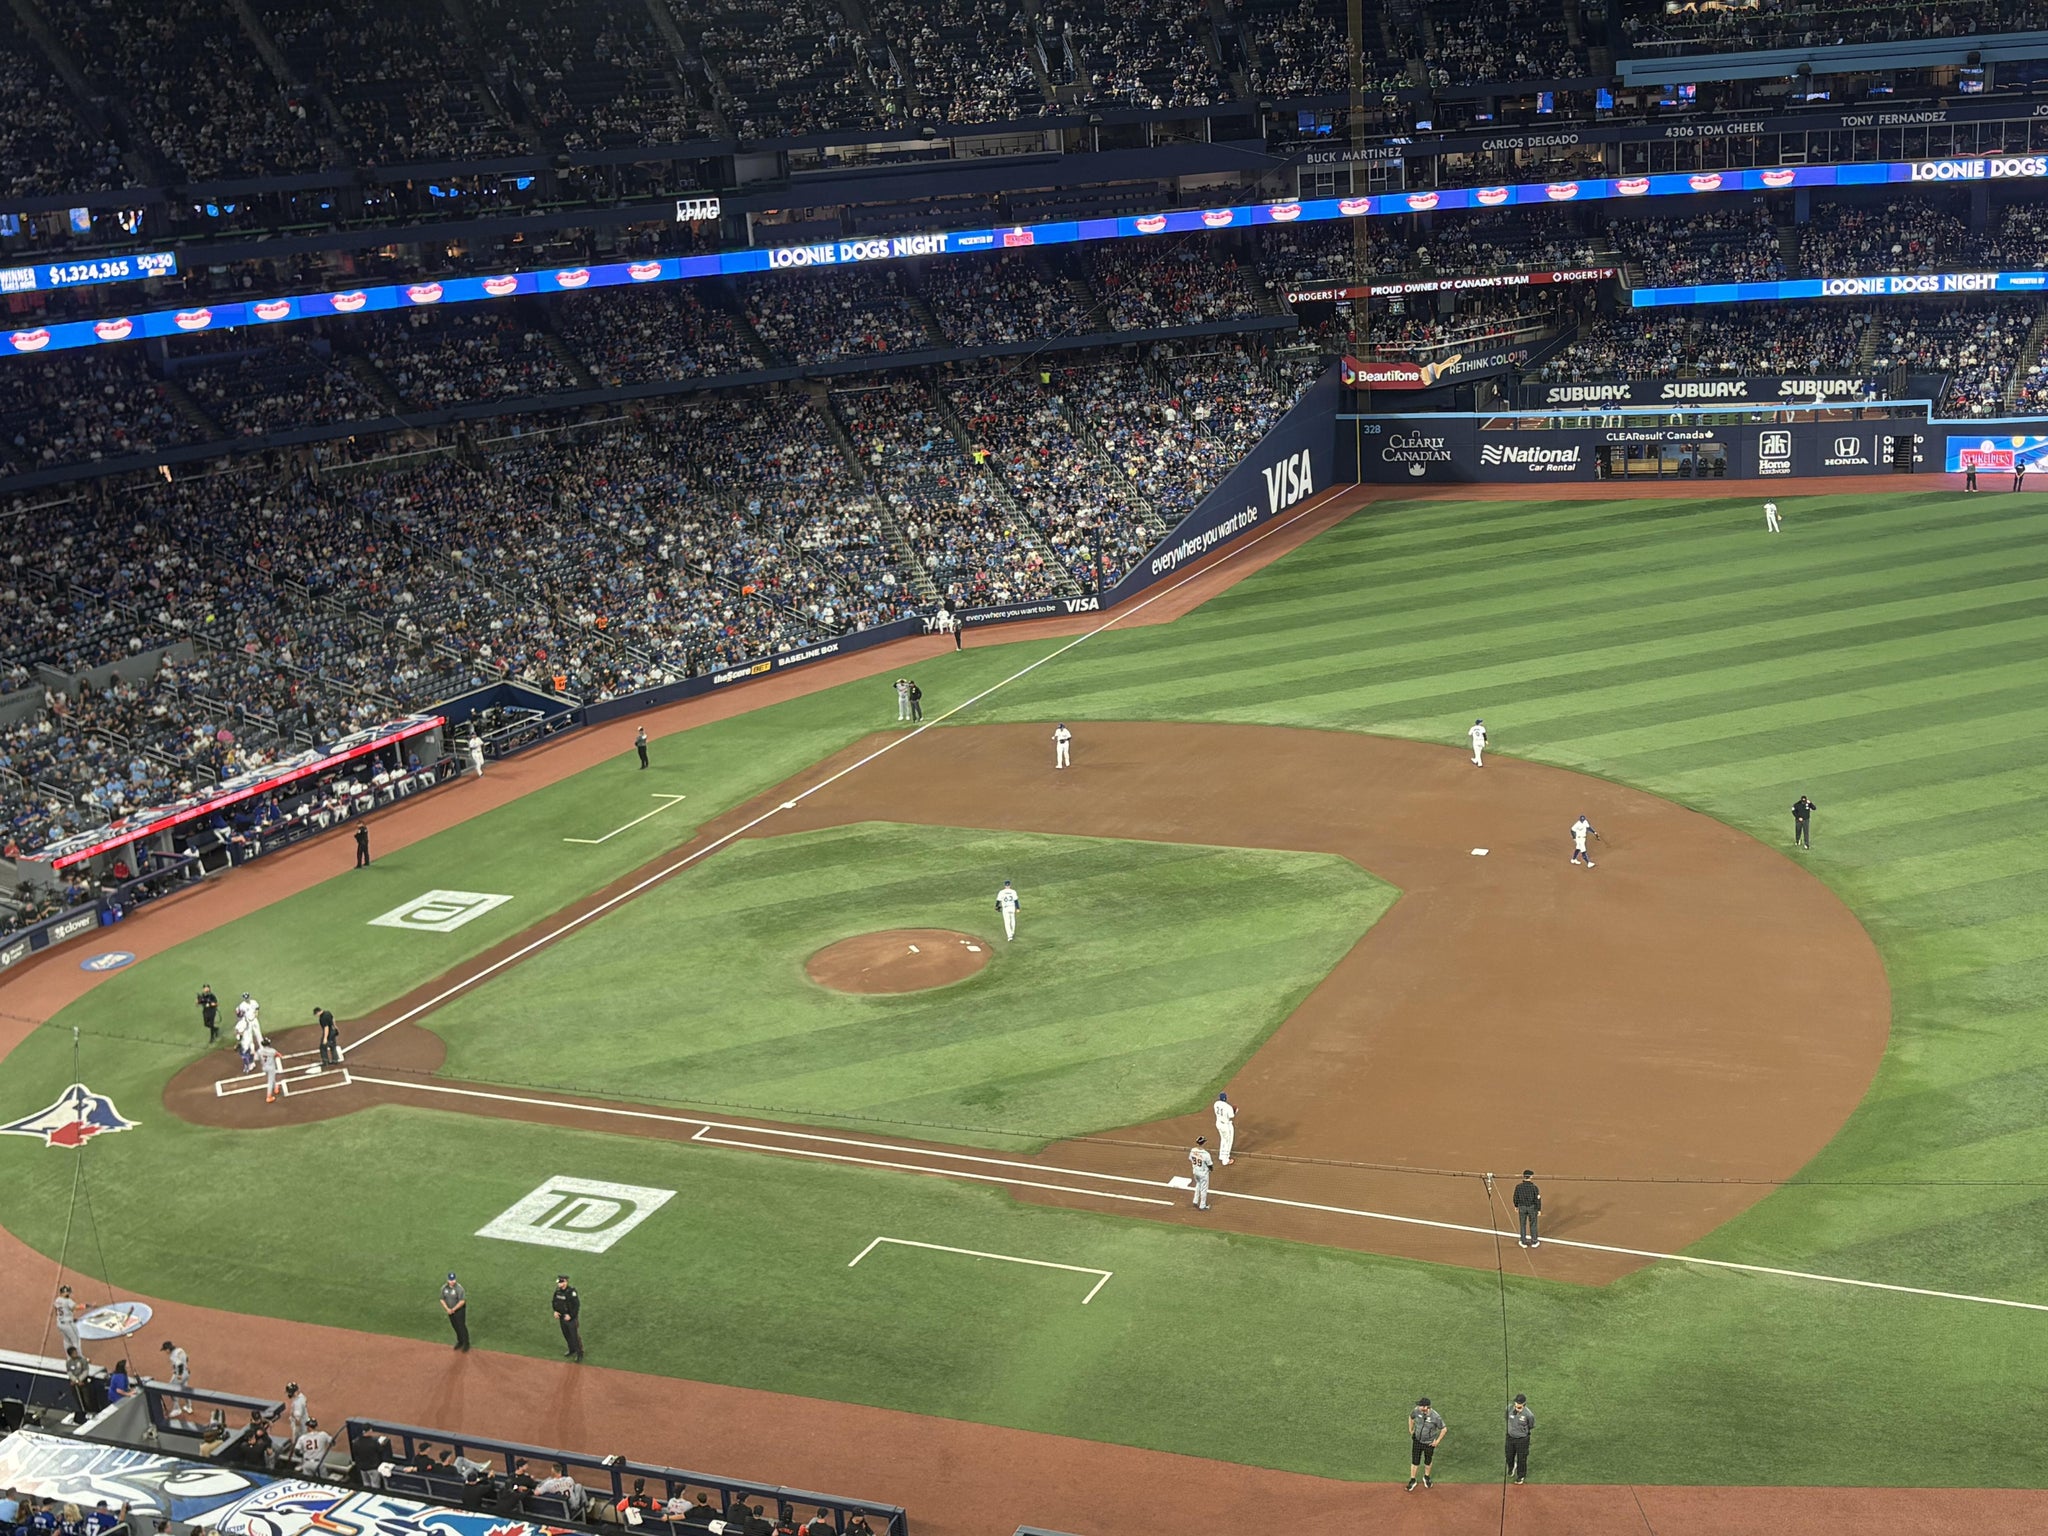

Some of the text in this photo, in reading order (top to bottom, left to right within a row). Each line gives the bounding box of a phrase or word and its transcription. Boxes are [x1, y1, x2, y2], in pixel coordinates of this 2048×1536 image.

[1841, 111, 1946, 127] TONY FERNANDEZ
[1664, 121, 1765, 138] 4306 TOM CHEEK
[1482, 134, 1579, 150] CARLOS DELGADO
[1307, 147, 1402, 164] BUCK MARTINEZ
[1911, 157, 2048, 181] LOONIE DOGS
[676, 206, 720, 223] KPMG
[769, 246, 837, 269] LOONIE
[840, 240, 890, 262] DOGS
[893, 234, 948, 256] NIGHT
[49, 260, 130, 285] $1,324,365
[1562, 270, 1598, 281] ROGERS
[1370, 275, 1530, 296] PROUD OWNER OF CANADA'S TEAM
[1821, 277, 1886, 296] LOONIE
[1890, 275, 1939, 292] DOGS
[1943, 273, 1999, 291] NIGHT
[1298, 291, 1333, 302] ROGERS
[1449, 349, 1528, 375] RETHINK COLOUR
[1358, 371, 1420, 382] BeautiTone
[1547, 384, 1631, 402] SUBWAY
[1661, 380, 1748, 399] SUBWAY
[1778, 379, 1863, 396] SUBWAY
[1364, 424, 1381, 434] 328
[1667, 431, 1705, 440] Canada
[1528, 463, 1576, 471] Car Rental
[1759, 460, 1790, 469] Home
[1824, 457, 1869, 466] HONDA
[1261, 448, 1313, 515] VISA
[1152, 505, 1258, 575] everywhere you want to be
[965, 604, 1056, 622] everywhere you want to be
[1063, 597, 1100, 613] VISA
[778, 643, 839, 667] BASELINE BOX
[713, 663, 770, 684] theScore BET
[64, 916, 90, 934] clover
[1191, 1156, 1203, 1167] 39
[528, 1189, 637, 1234] TD
[305, 1439, 318, 1451] 21
